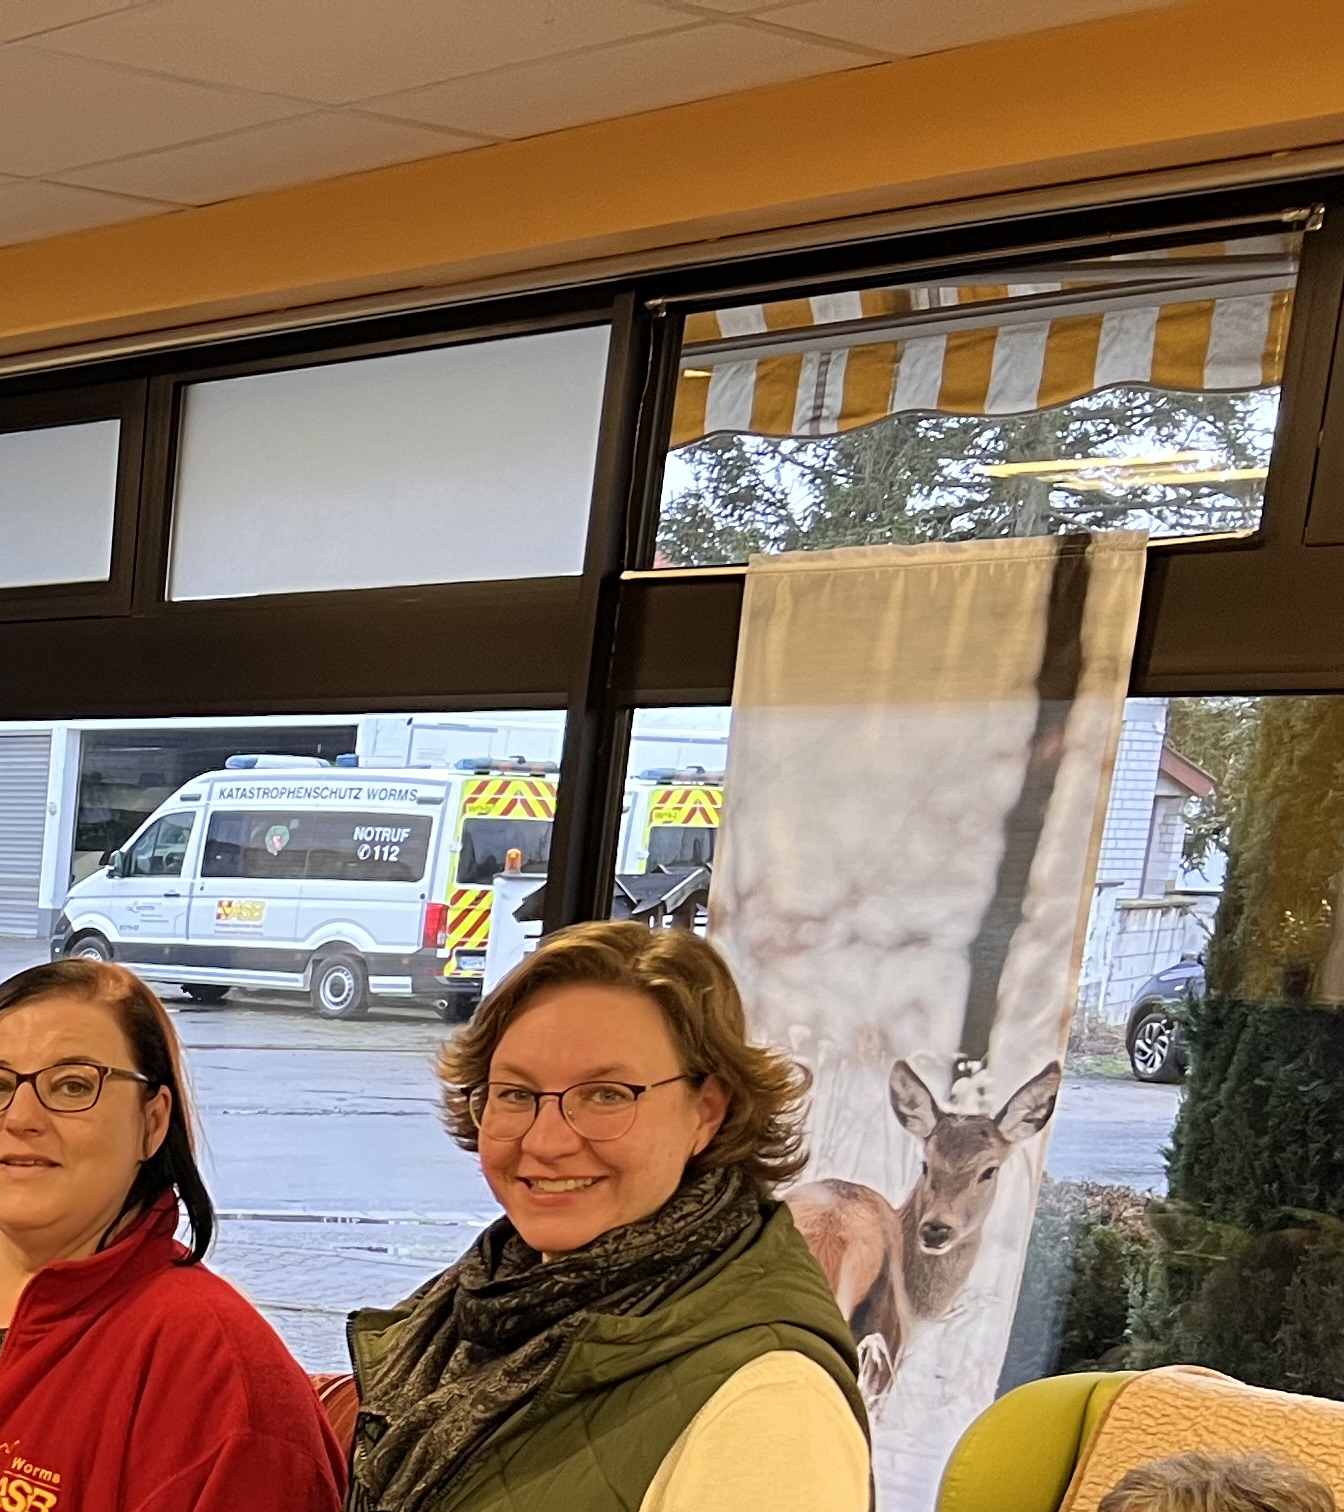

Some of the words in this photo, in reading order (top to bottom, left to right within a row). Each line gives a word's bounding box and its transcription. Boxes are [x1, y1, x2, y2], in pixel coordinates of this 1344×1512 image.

[218, 786, 362, 800] KATASTROPHENSCHUTZ
[366, 787, 419, 801] WORMS
[353, 826, 411, 843] NOTRUF
[372, 845, 400, 862] 112
[229, 900, 266, 922] ASB
[11, 1456, 61, 1484] Worms
